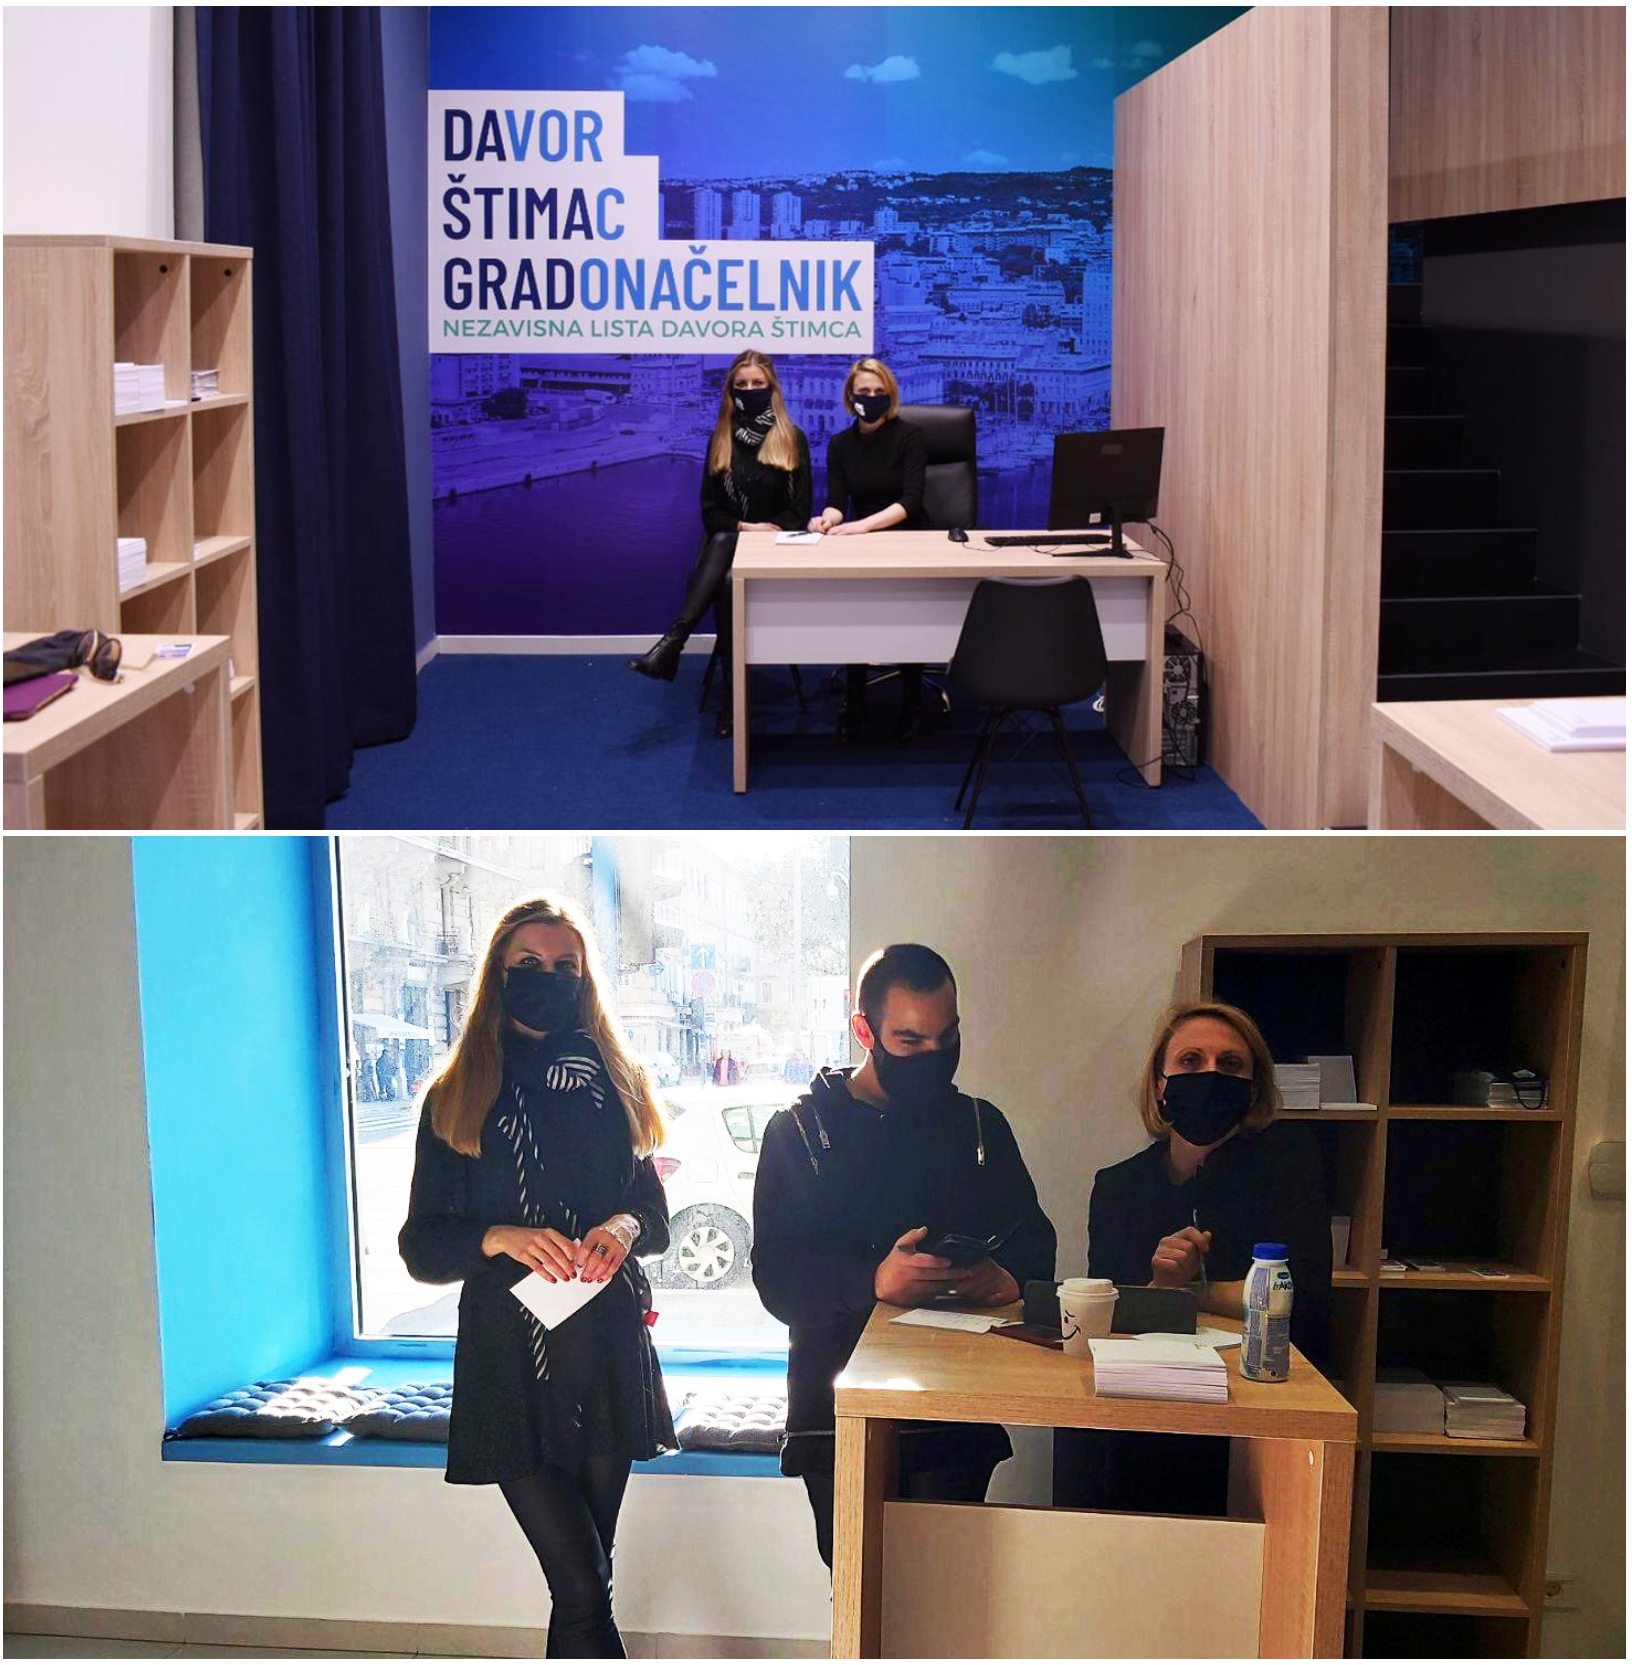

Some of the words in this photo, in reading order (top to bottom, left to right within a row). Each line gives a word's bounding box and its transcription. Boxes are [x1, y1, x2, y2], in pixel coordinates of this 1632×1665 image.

[443, 109, 603, 162] DAVOR
[443, 173, 625, 240] ŠTIMAC
[443, 245, 862, 311] GRADONAČELNIK
[443, 319, 583, 337] NEZAVISNA
[591, 319, 654, 338] LISTA
[662, 320, 764, 338] DAVORA
[771, 316, 862, 339] ŠTIMCA
